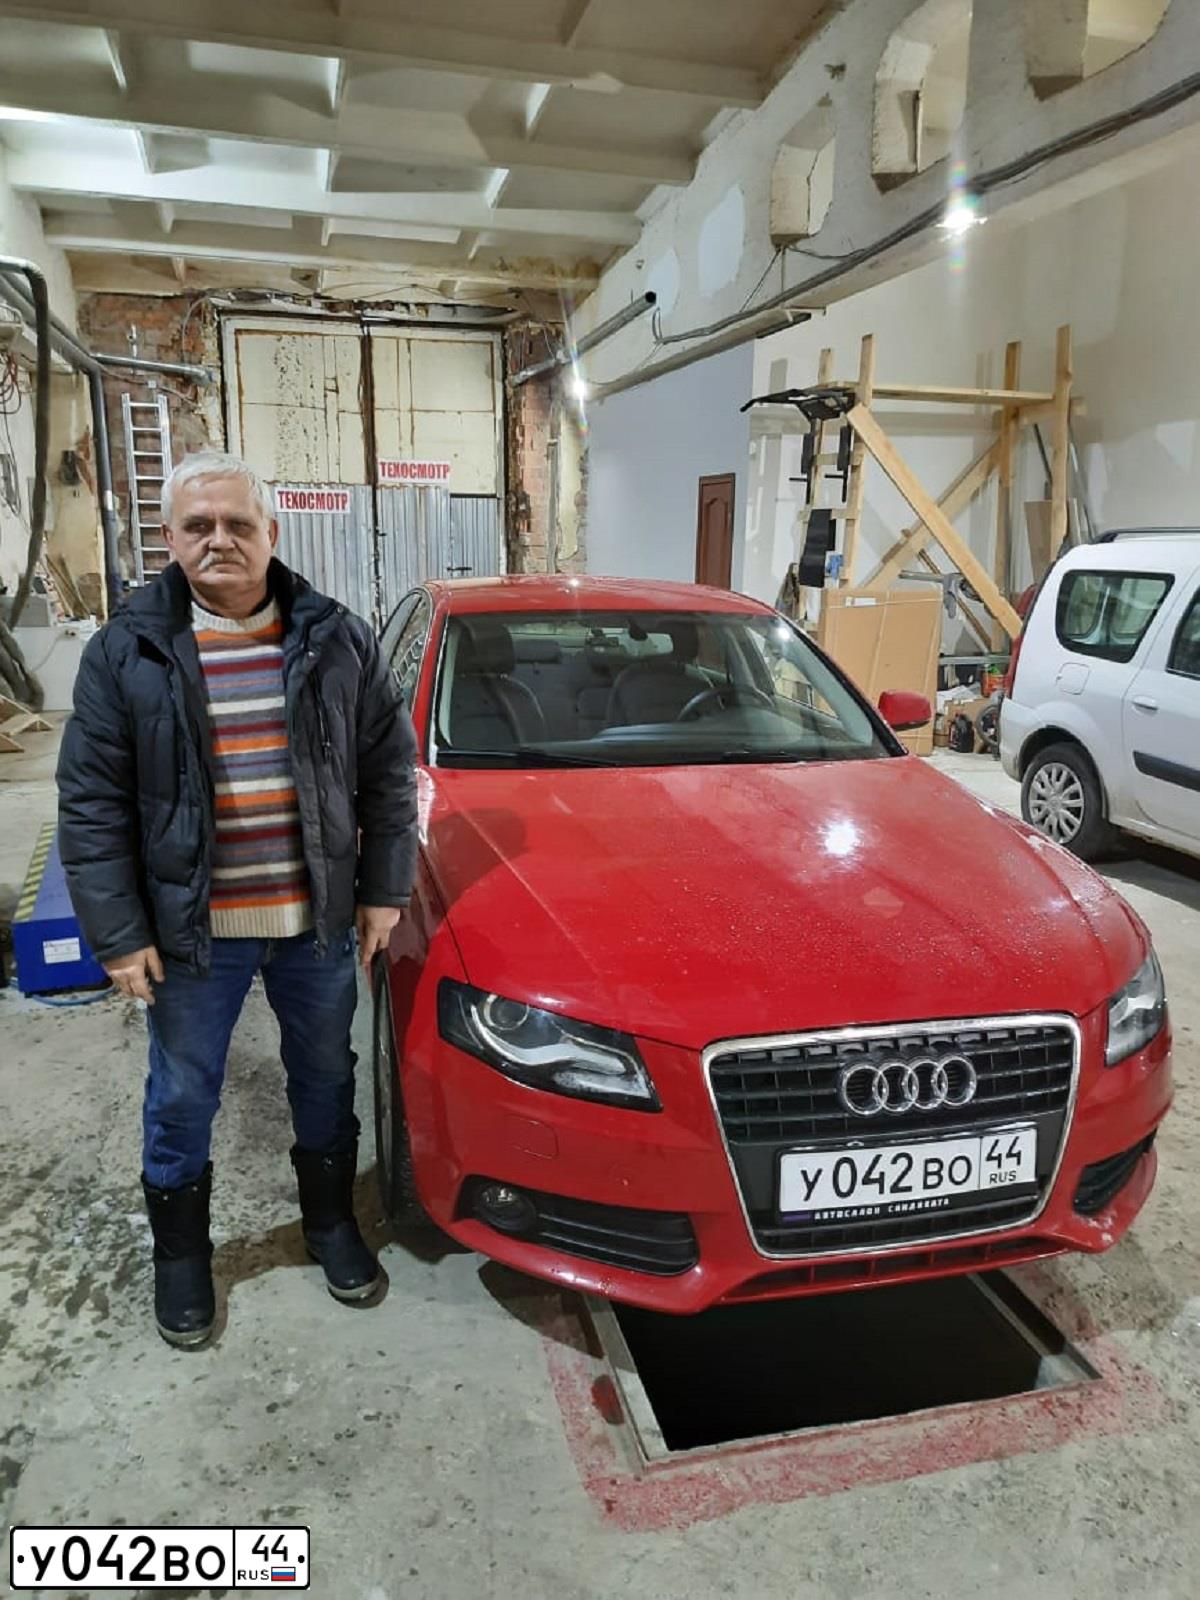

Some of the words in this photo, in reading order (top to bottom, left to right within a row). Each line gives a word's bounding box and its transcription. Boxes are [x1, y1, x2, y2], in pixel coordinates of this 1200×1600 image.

[379, 461, 450, 479] ТЕХОСМОТР
[277, 490, 348, 510] ТЕХОСМОТР
[985, 1135, 1022, 1169] 44
[989, 1170, 1017, 1184] RUS
